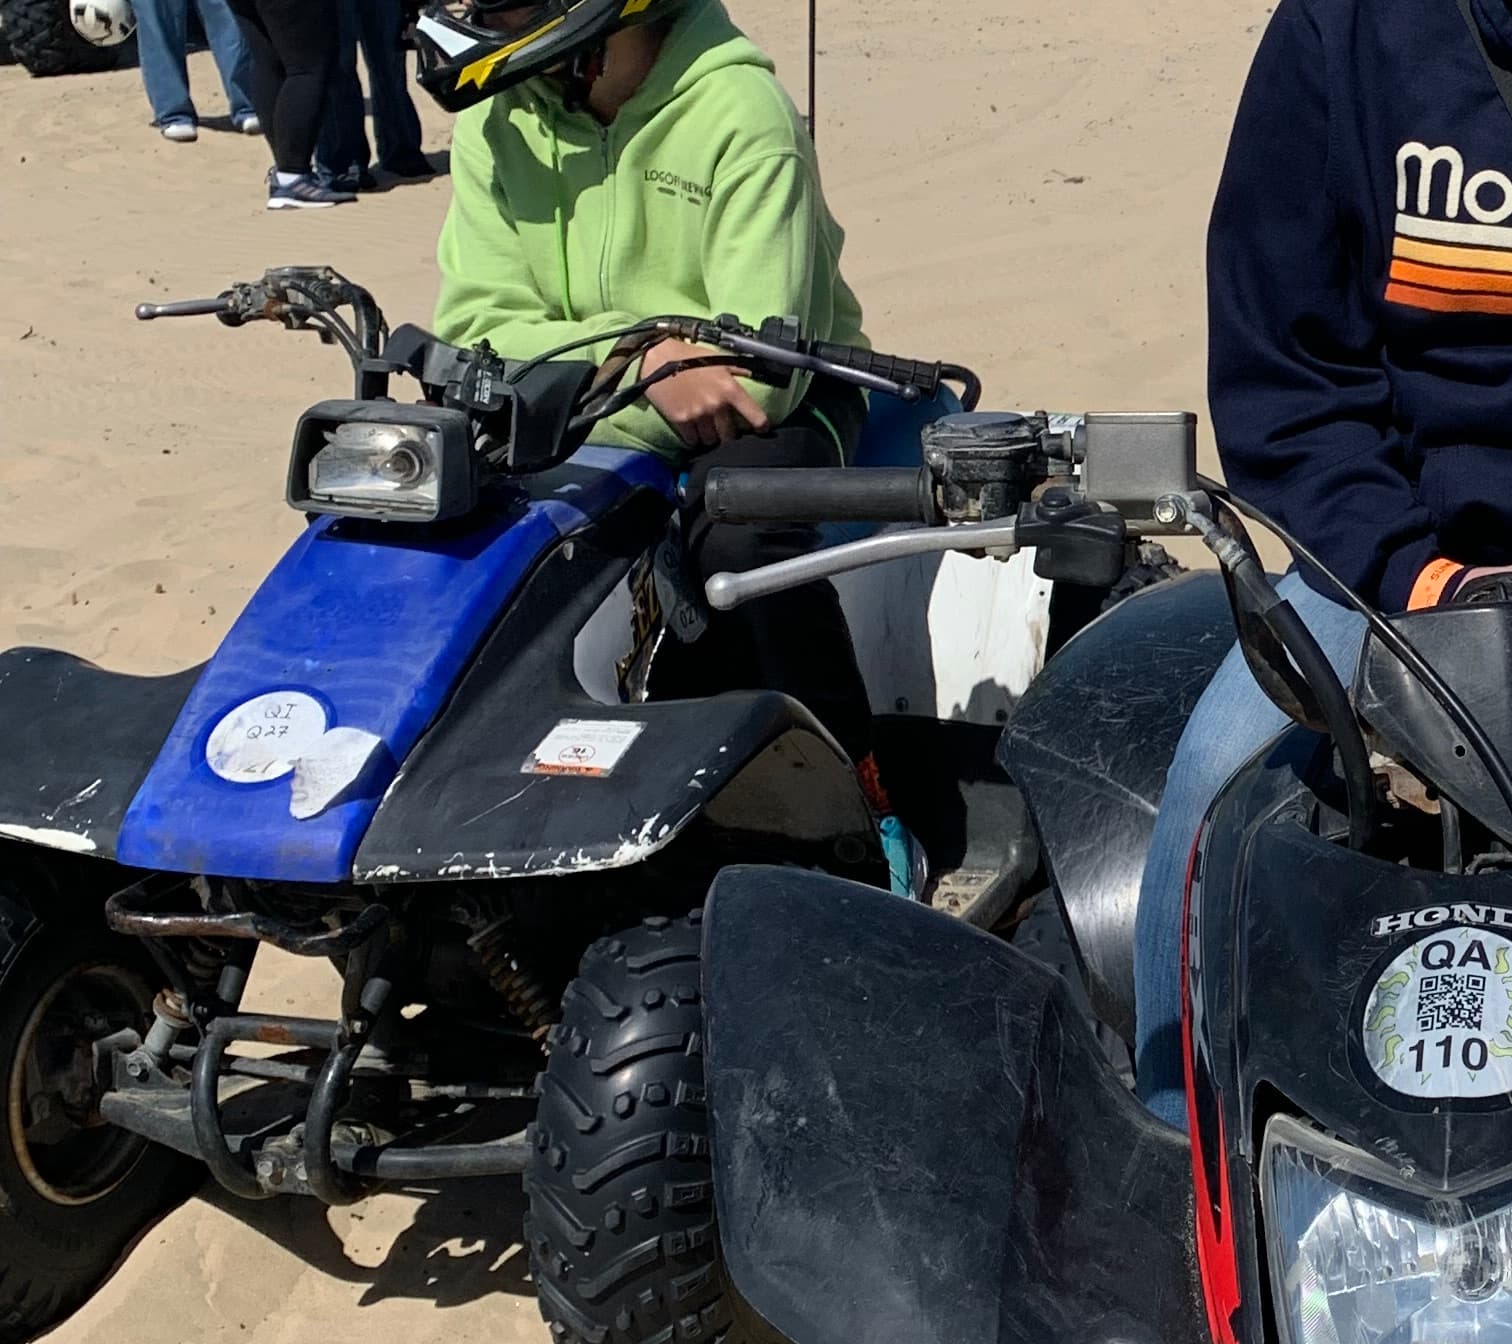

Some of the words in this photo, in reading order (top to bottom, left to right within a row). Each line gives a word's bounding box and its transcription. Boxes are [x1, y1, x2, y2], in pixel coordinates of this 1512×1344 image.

[246, 725, 289, 739] Q27
[1420, 939, 1492, 972] QA
[1408, 1035, 1489, 1073] 110
